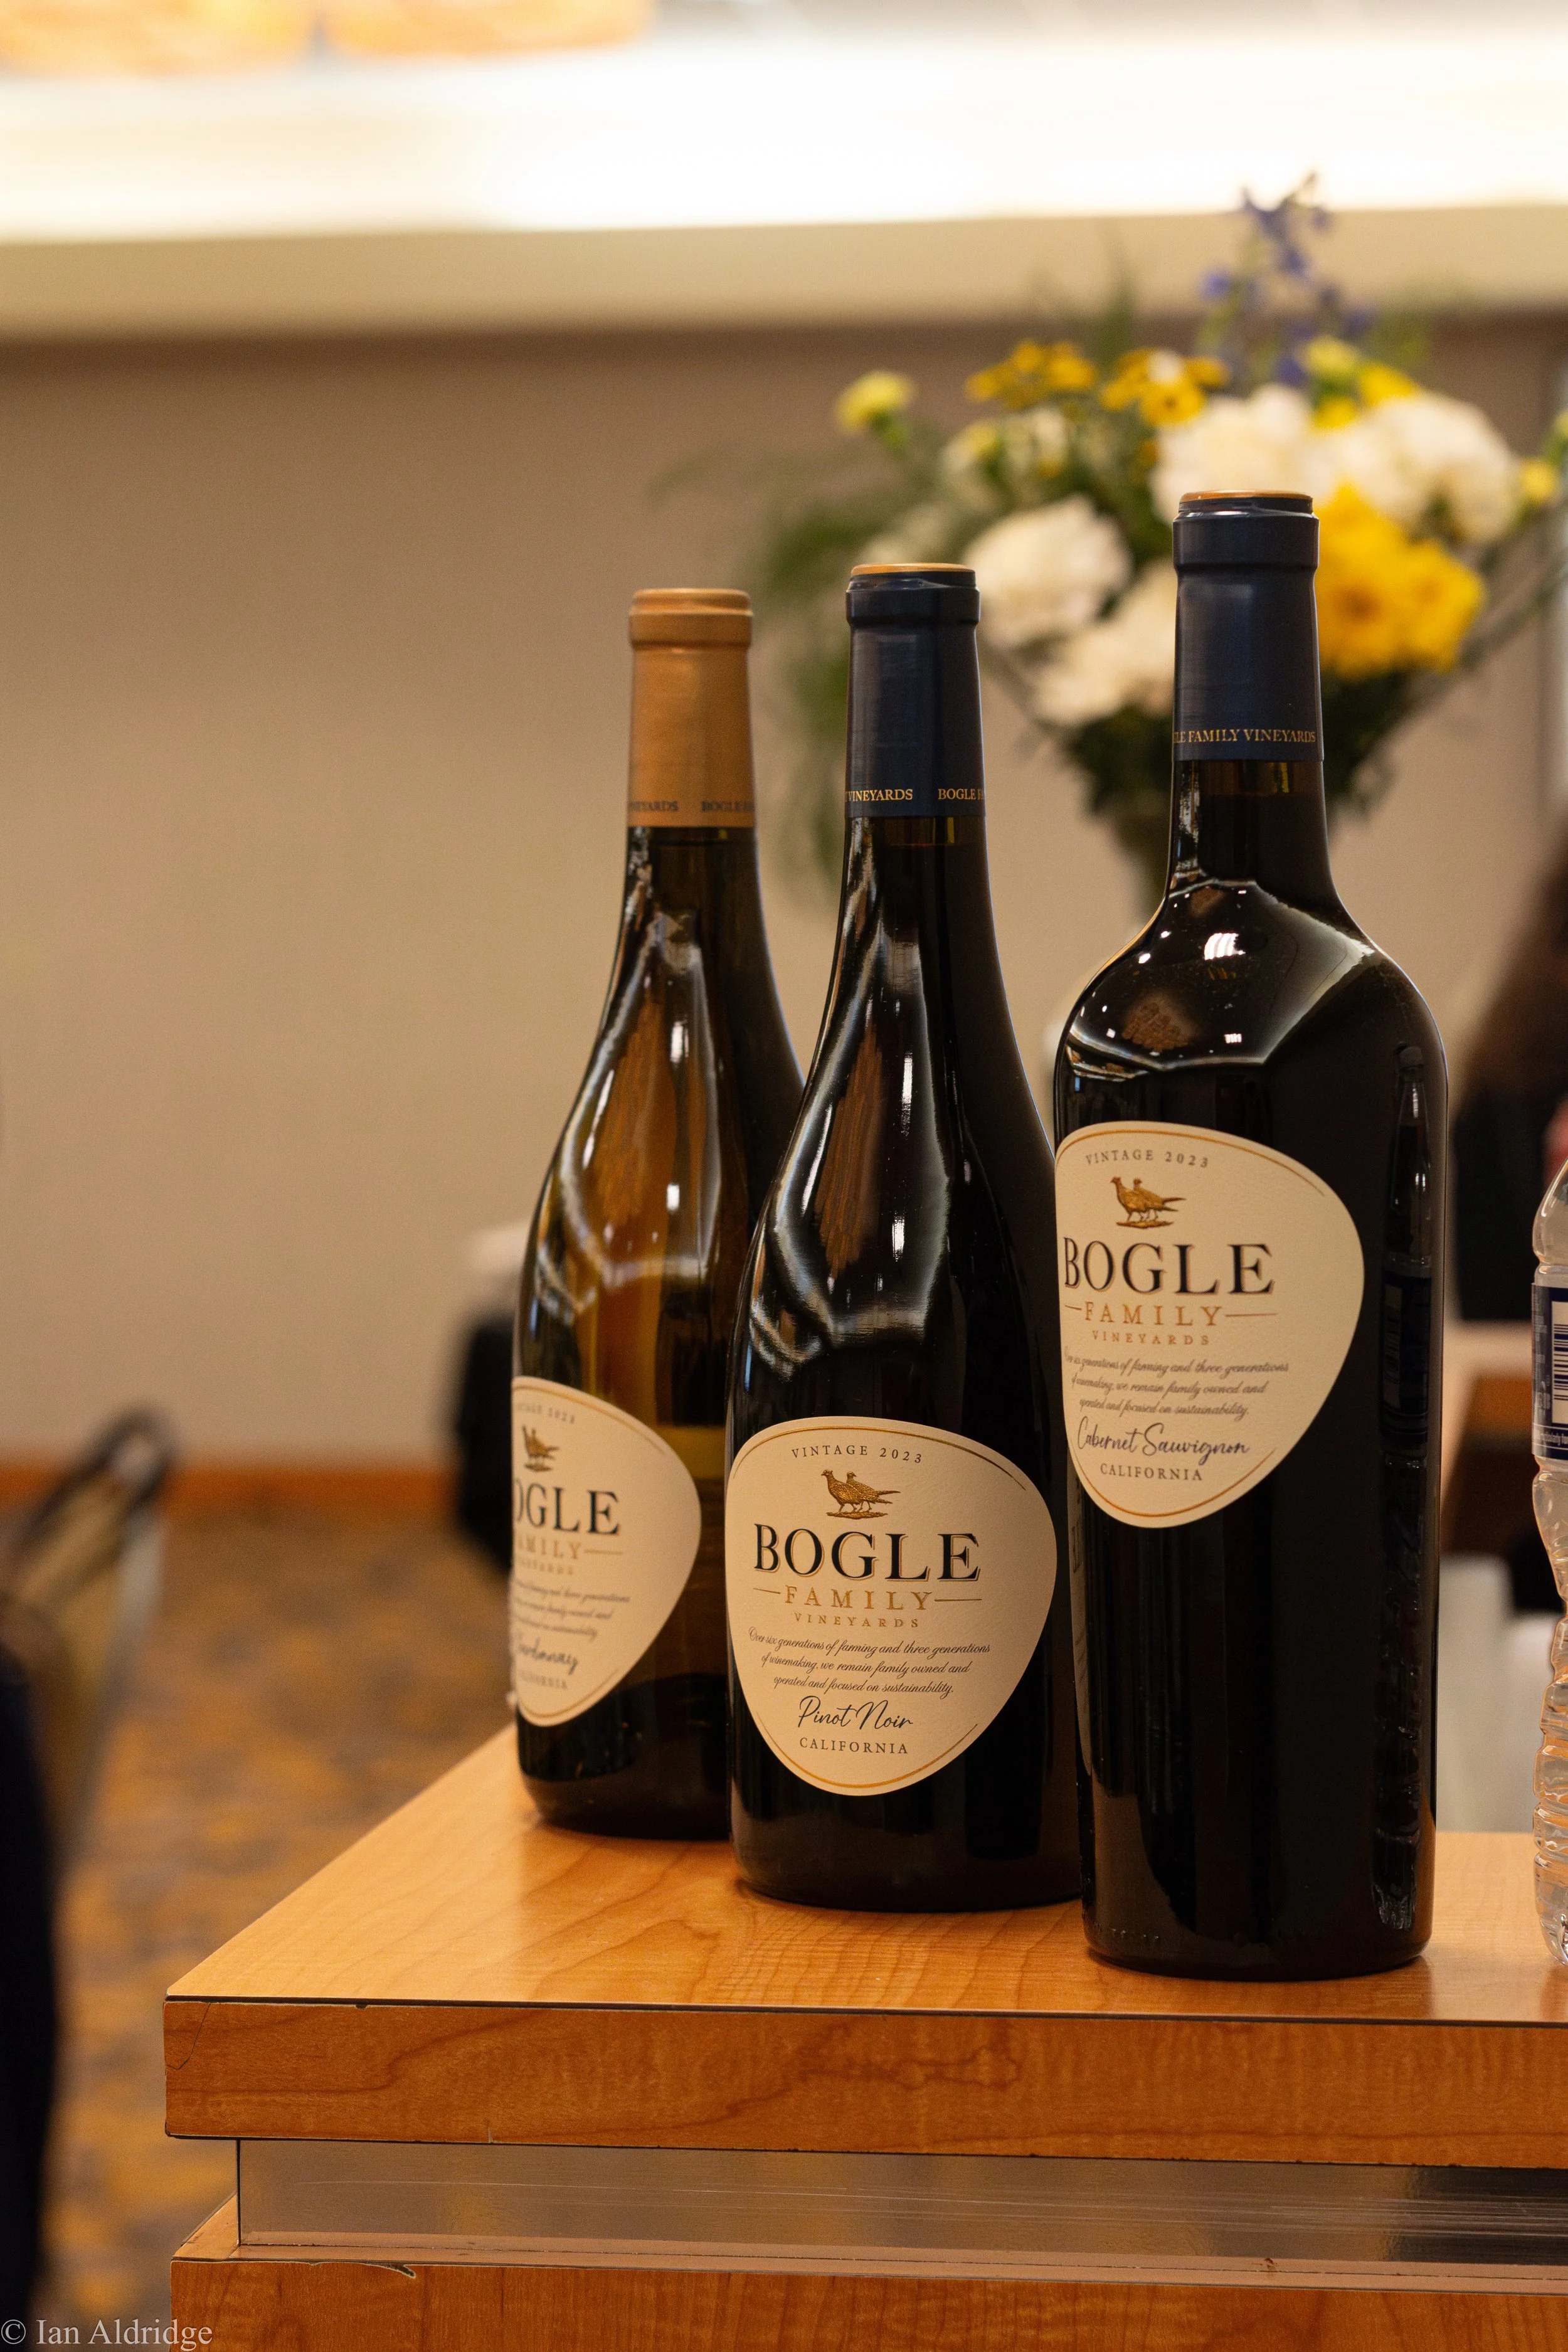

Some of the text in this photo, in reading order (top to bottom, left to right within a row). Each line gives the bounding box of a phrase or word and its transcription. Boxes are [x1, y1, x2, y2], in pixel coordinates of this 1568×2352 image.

[1188, 729, 1240, 743] FAMILY
[1243, 729, 1316, 743] VINEYARDS
[848, 788, 913, 802] VINEYARDS
[938, 788, 976, 800] BOGLE
[1085, 1148, 1209, 1168] VINTAGE 2023
[1063, 1237, 1276, 1296] BOGLE
[1084, 1301, 1222, 1327] FAMILY
[1092, 1330, 1209, 1346] VINEYARDS
[1170, 1359, 1195, 1374] and
[1195, 1359, 1223, 1374] three
[1219, 1362, 1289, 1380] generations
[1162, 1380, 1201, 1401] family
[1242, 1380, 1270, 1394] and
[1078, 1416, 1250, 1466] Cabernet Sauvignon
[791, 1444, 922, 1464] VINTAGE 2023
[1100, 1463, 1203, 1481] CALIFORNIA
[753, 1523, 982, 1582] BOGLE
[784, 1584, 933, 1611] FAMILY
[793, 1611, 919, 1629] VINEYARDS
[748, 1626, 990, 1660] Over six generations of farming and three generations
[761, 1651, 771, 1668] of
[820, 1661, 834, 1670] we
[837, 1662, 873, 1672] remain
[869, 1660, 910, 1680] family
[911, 1661, 950, 1673] owned
[948, 1661, 973, 1673] and
[773, 1675, 954, 1700] operated and focused on sustainability.
[797, 1695, 914, 1730] Pinot Noir
[799, 1737, 908, 1754] CALIFORNIA
